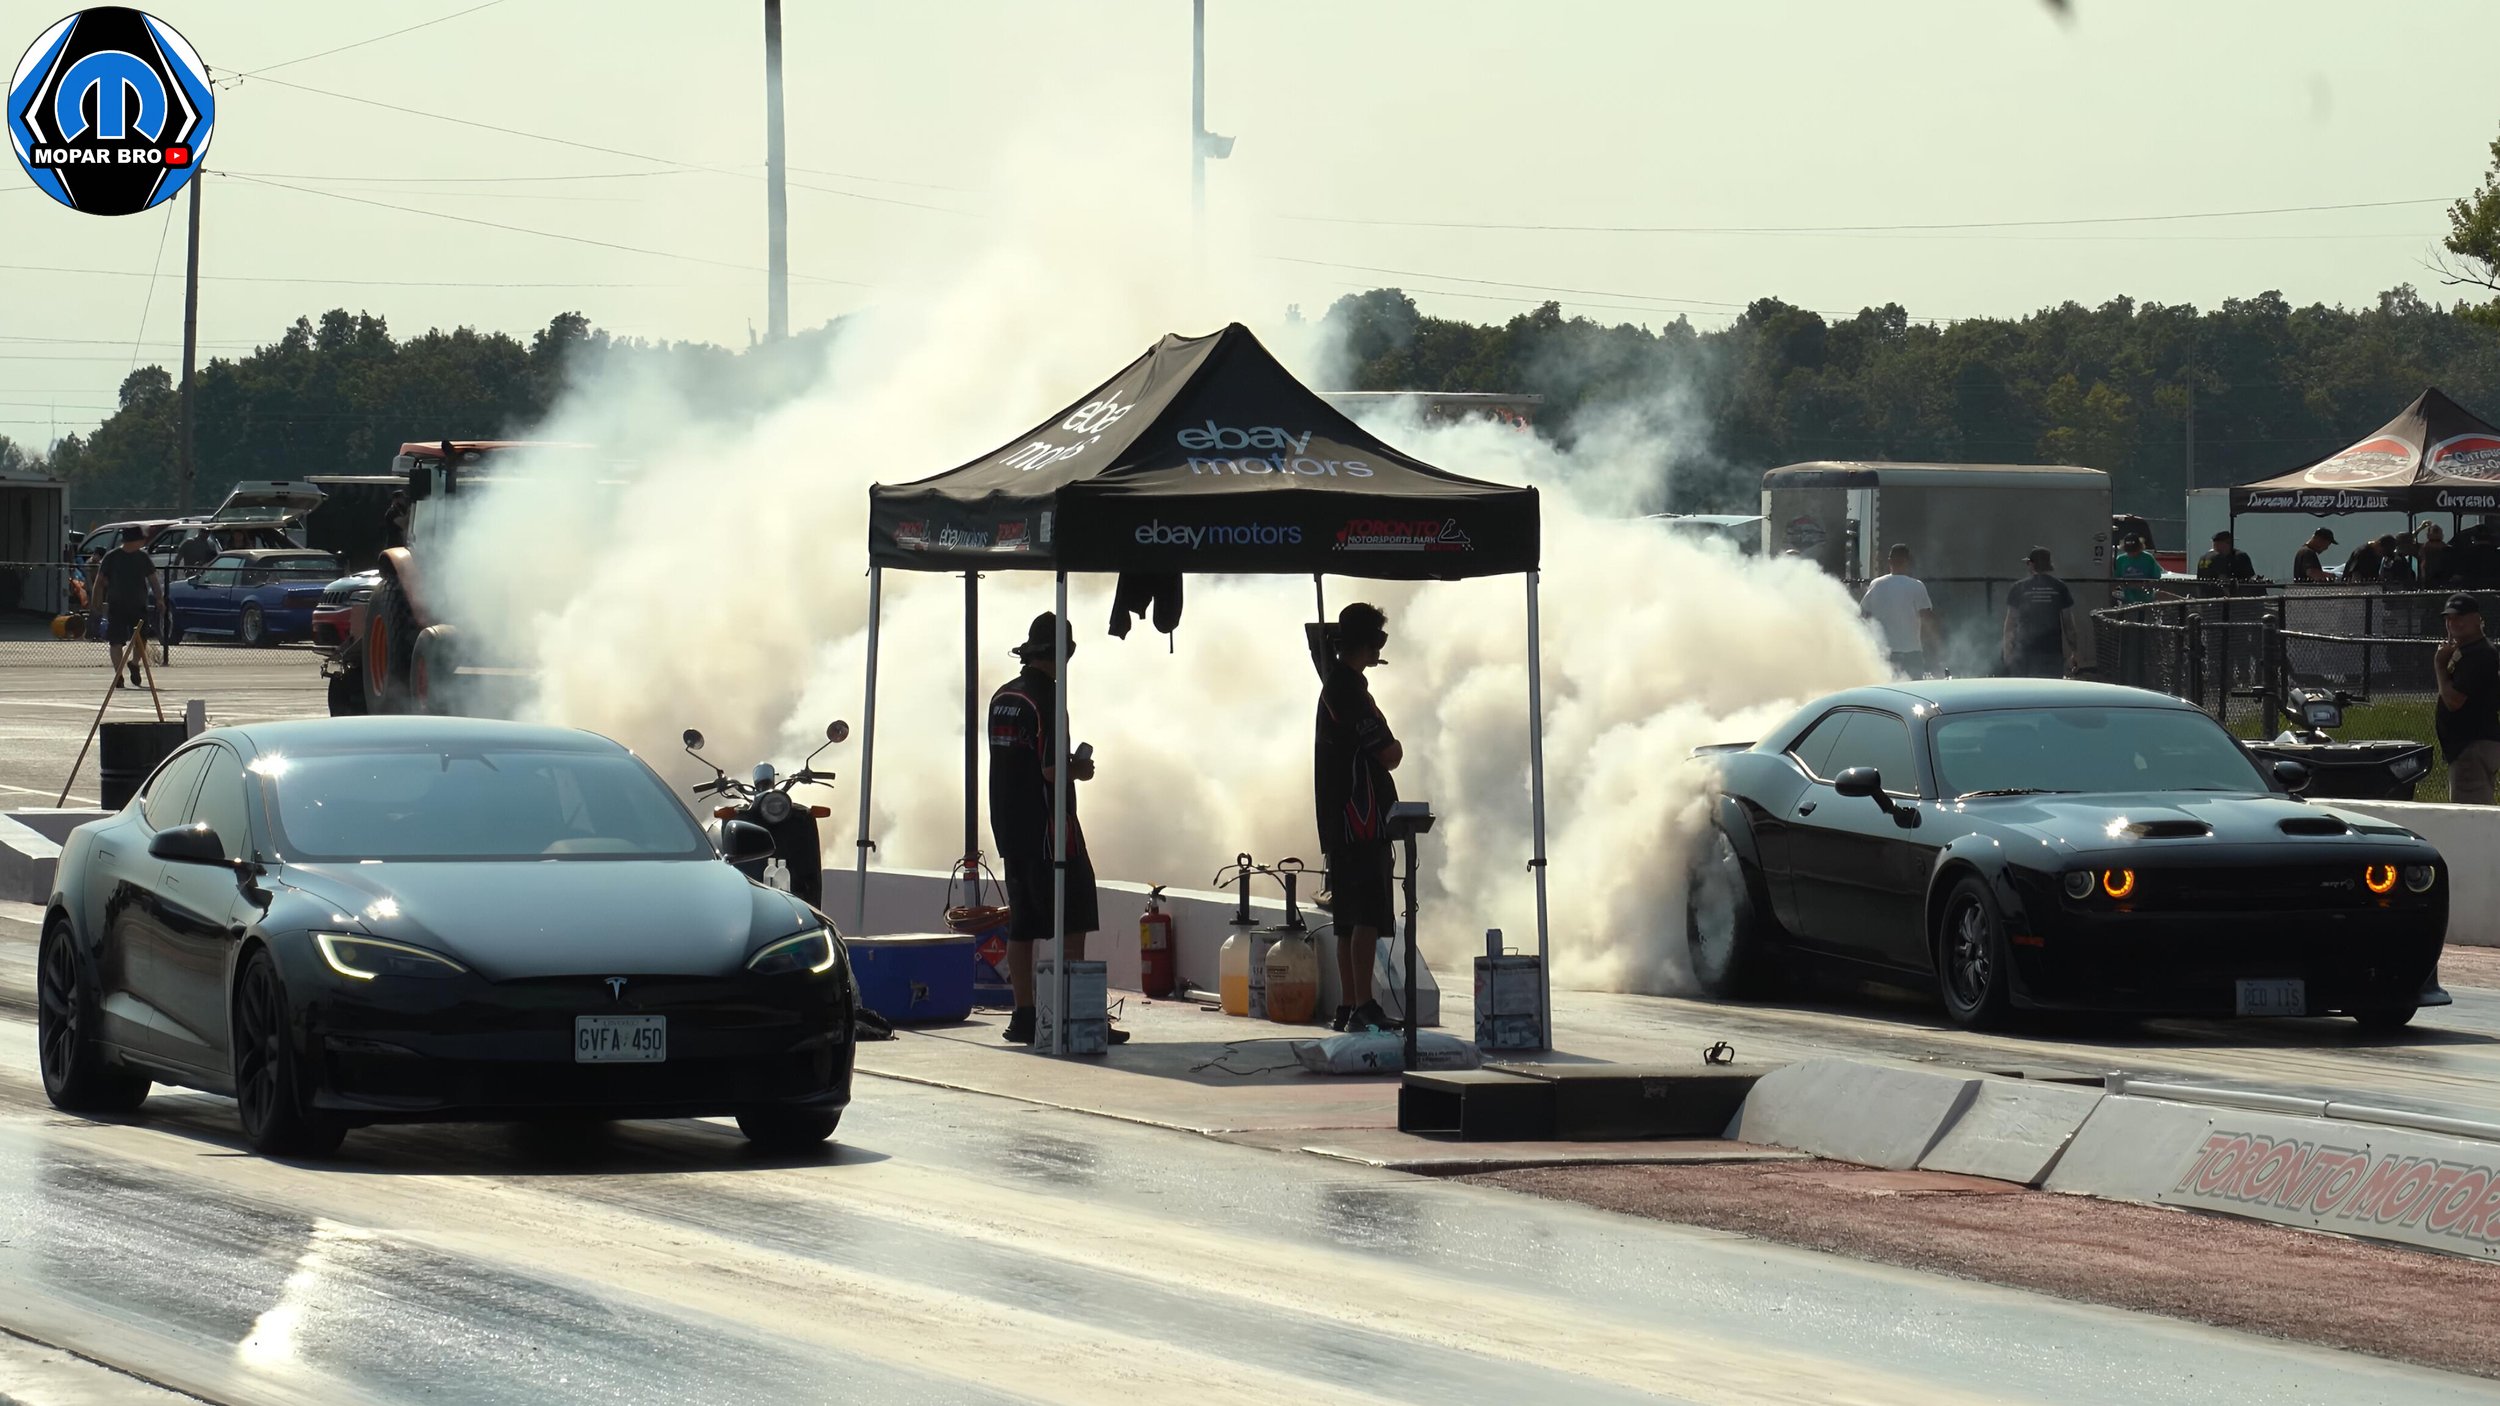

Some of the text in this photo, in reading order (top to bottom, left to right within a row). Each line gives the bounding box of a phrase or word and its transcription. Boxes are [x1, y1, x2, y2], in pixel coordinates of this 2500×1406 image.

[1062, 389, 1136, 434] eba
[1177, 419, 1313, 455] ebay
[1187, 452, 1374, 478] motors
[1345, 519, 1441, 537] TORONTO
[1347, 535, 1437, 544] MOTORSPORTS PARK
[580, 1027, 662, 1052] GVFA 450
[2173, 1130, 2371, 1216] TORONTO
